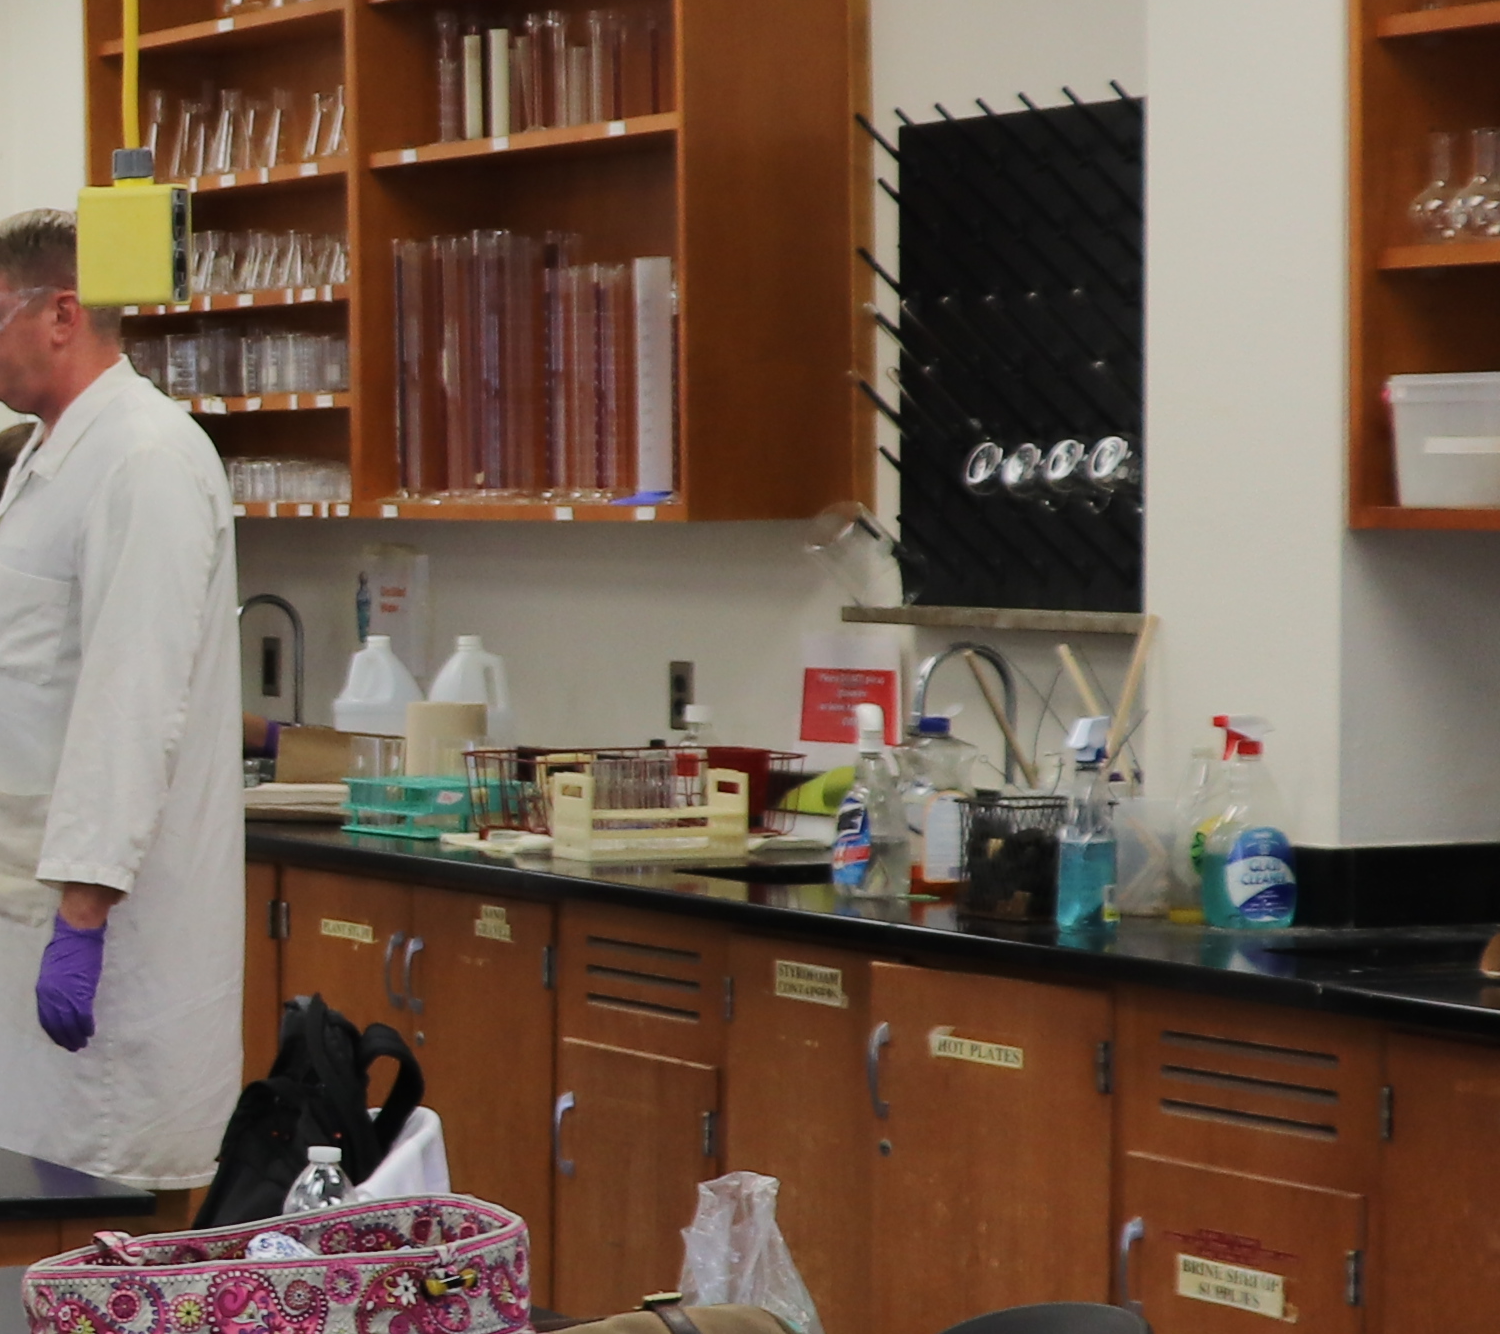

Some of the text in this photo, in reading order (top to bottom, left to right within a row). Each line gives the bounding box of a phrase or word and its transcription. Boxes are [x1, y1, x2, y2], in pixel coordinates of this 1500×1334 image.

[938, 1039, 1020, 1063] HOT PLATES
[1182, 1257, 1222, 1280] BRINE
